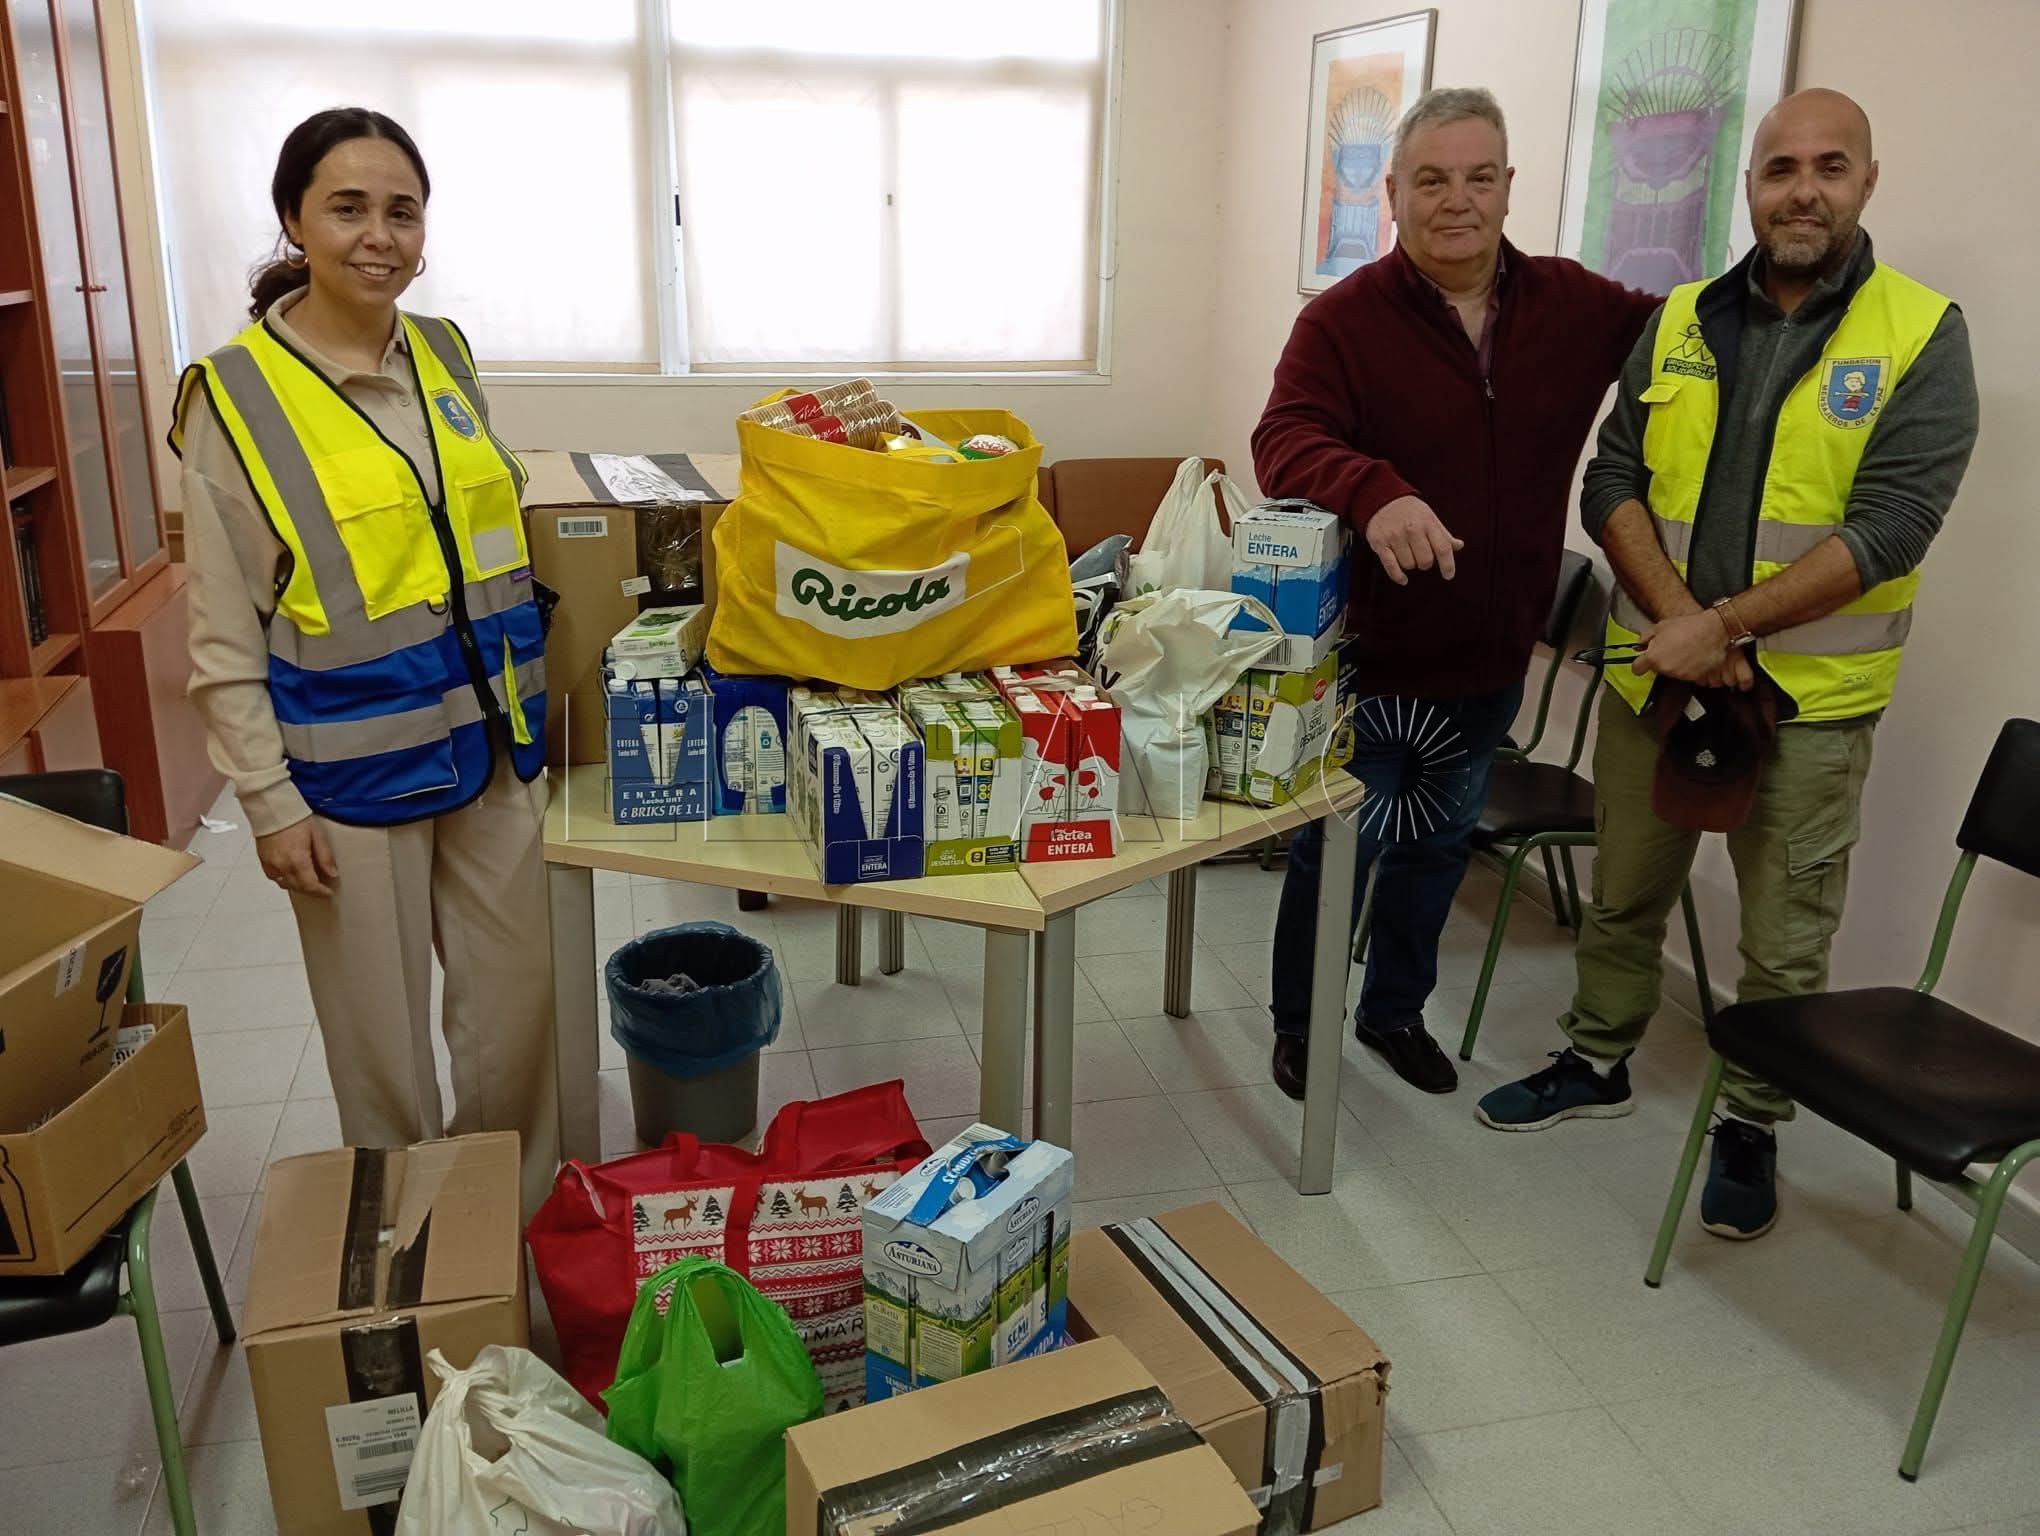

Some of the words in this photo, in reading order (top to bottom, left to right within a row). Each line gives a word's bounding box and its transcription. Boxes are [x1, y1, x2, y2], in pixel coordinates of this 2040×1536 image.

[1665, 364, 1714, 379] SOLIDARIDAD
[1692, 362, 1708, 372] POR
[1820, 384, 1849, 427] MENSAJEROS
[1855, 417, 1867, 426] DE
[1870, 406, 1881, 417] LA
[1876, 387, 1884, 402] PAZ
[1249, 532, 1272, 543] Leche
[1248, 542, 1299, 559] ENTERA
[792, 568, 950, 621] Ricola
[623, 788, 697, 800] ENTERA
[620, 807, 628, 818] 6
[631, 805, 665, 818] BRIKS
[669, 804, 683, 816] DE
[686, 803, 692, 814] 1
[1047, 842, 1095, 856] ENTERA
[862, 861, 888, 872] ENTERA
[1010, 1203, 1038, 1229] ASTURIANA
[888, 1246, 938, 1273] ASTURIANA
[1008, 1314, 1029, 1347] SEMI
